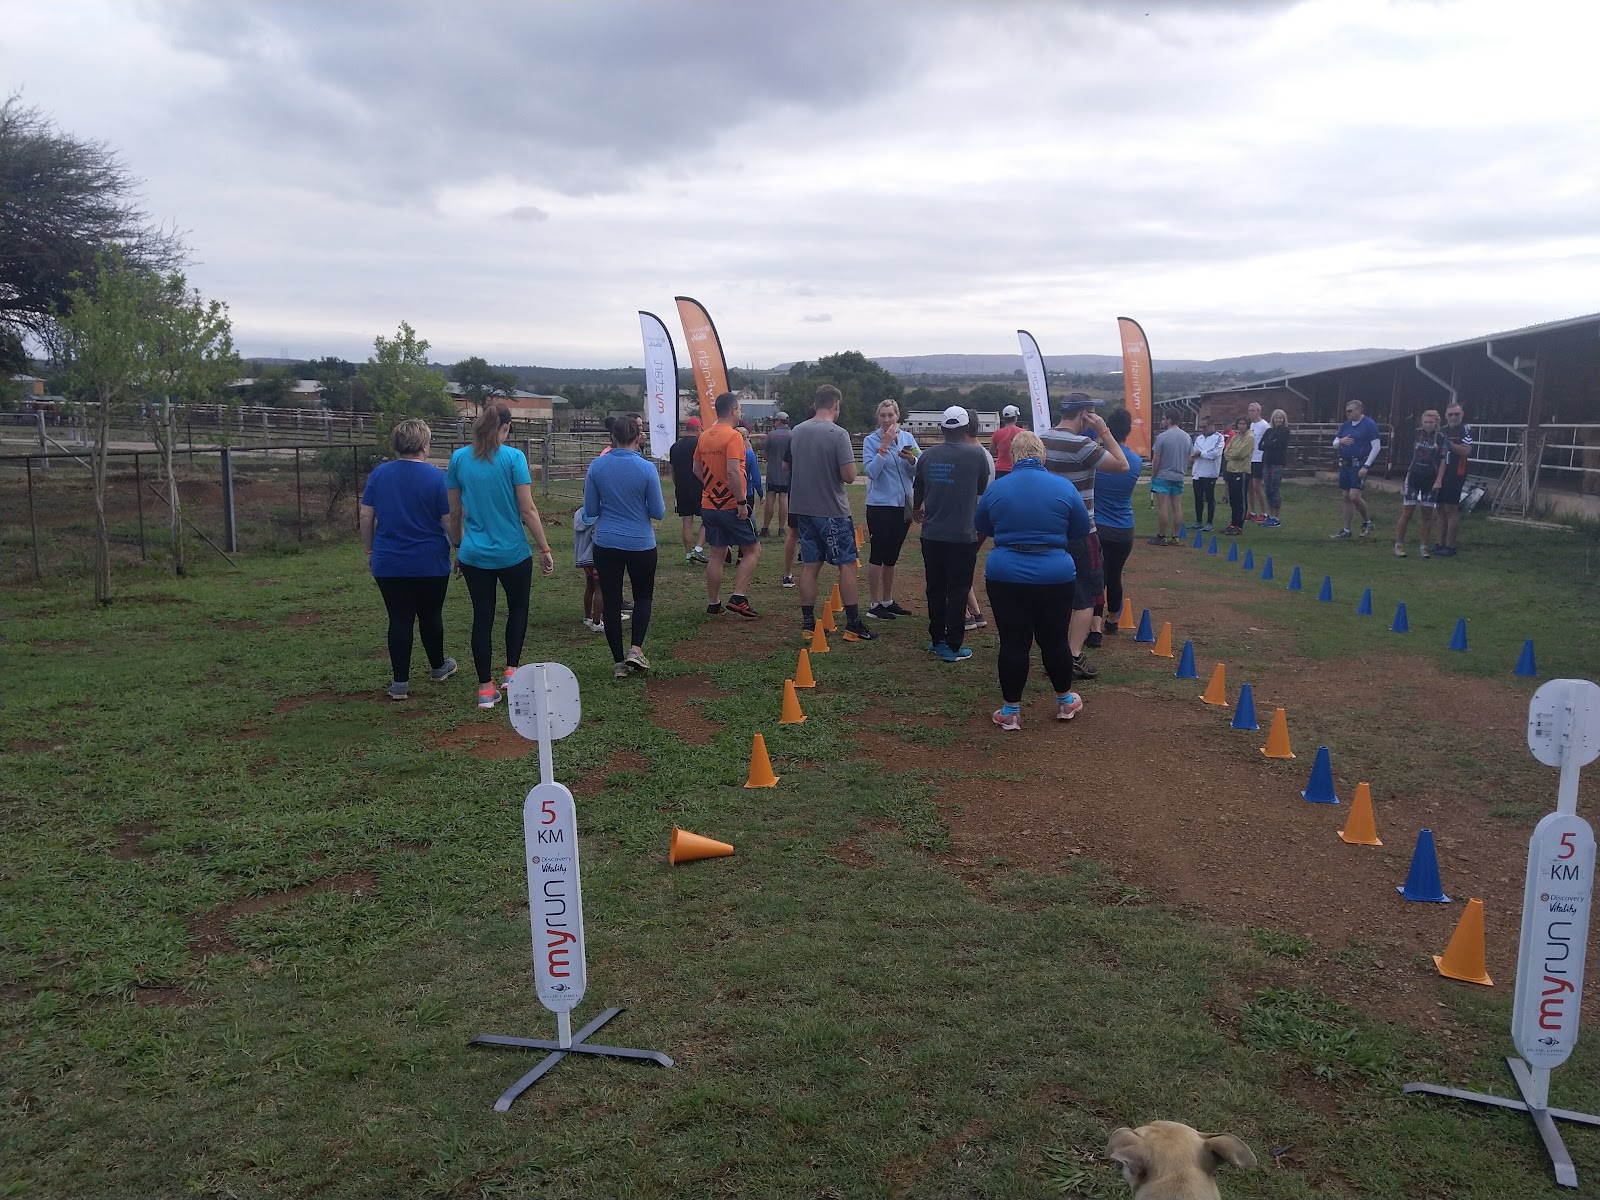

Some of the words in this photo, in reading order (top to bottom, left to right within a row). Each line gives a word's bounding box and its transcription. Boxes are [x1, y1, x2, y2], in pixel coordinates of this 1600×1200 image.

[541, 800, 556, 825] 5
[537, 829, 564, 844] KM
[1557, 832, 1577, 860] 5
[541, 862, 567, 875] Vitality
[1550, 864, 1579, 881] KM
[1550, 894, 1585, 903] Discovery
[1549, 902, 1577, 916] Vitality
[543, 880, 577, 978] myrun
[1538, 921, 1575, 1030] myrun
